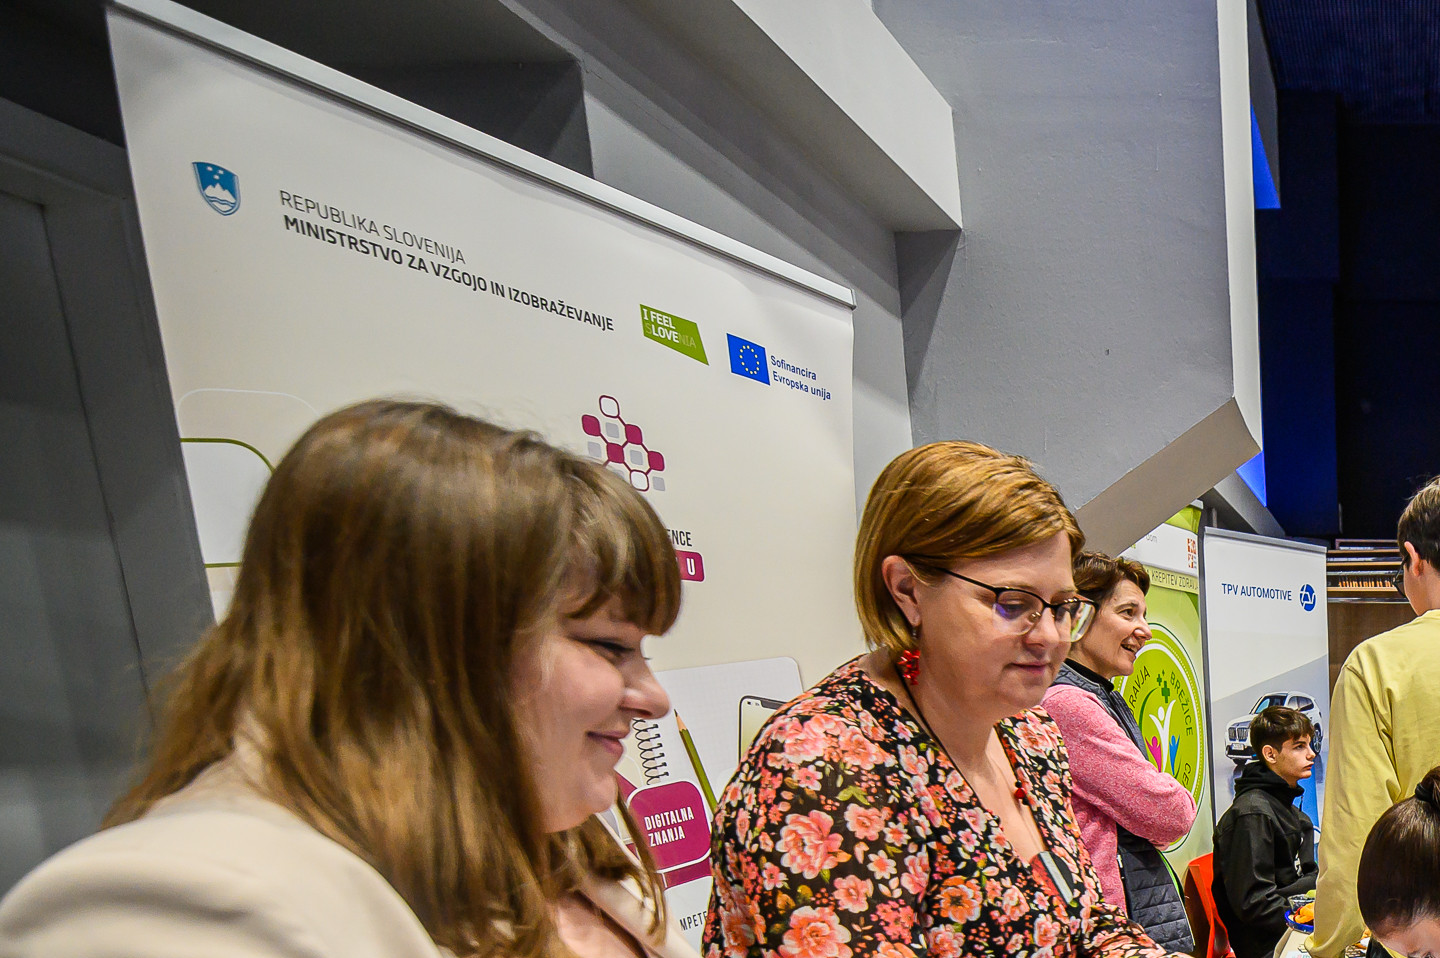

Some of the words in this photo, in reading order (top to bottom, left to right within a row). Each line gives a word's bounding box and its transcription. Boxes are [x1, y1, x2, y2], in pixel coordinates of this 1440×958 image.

[280, 190, 380, 237] REPUBLIKA
[383, 224, 466, 264] SLOVENIJA
[283, 215, 403, 265] MINISTRSTVO
[406, 253, 428, 273] ZA
[431, 261, 487, 292] VZGOJO
[490, 280, 505, 298] IN
[508, 287, 614, 332] IZOBRAŽEVANJE
[643, 308, 649, 321] I
[650, 311, 676, 329] FEEL
[770, 355, 817, 381] Sofinancira
[773, 371, 809, 393] Evropska
[811, 386, 831, 401] unija
[1221, 583, 1238, 596] TPV
[1240, 585, 1292, 601] AUTOMOTIVE
[1170, 671, 1194, 737] BREŽICE
[644, 806, 695, 831] DIGITALNA
[648, 825, 686, 847] ZNANJA
